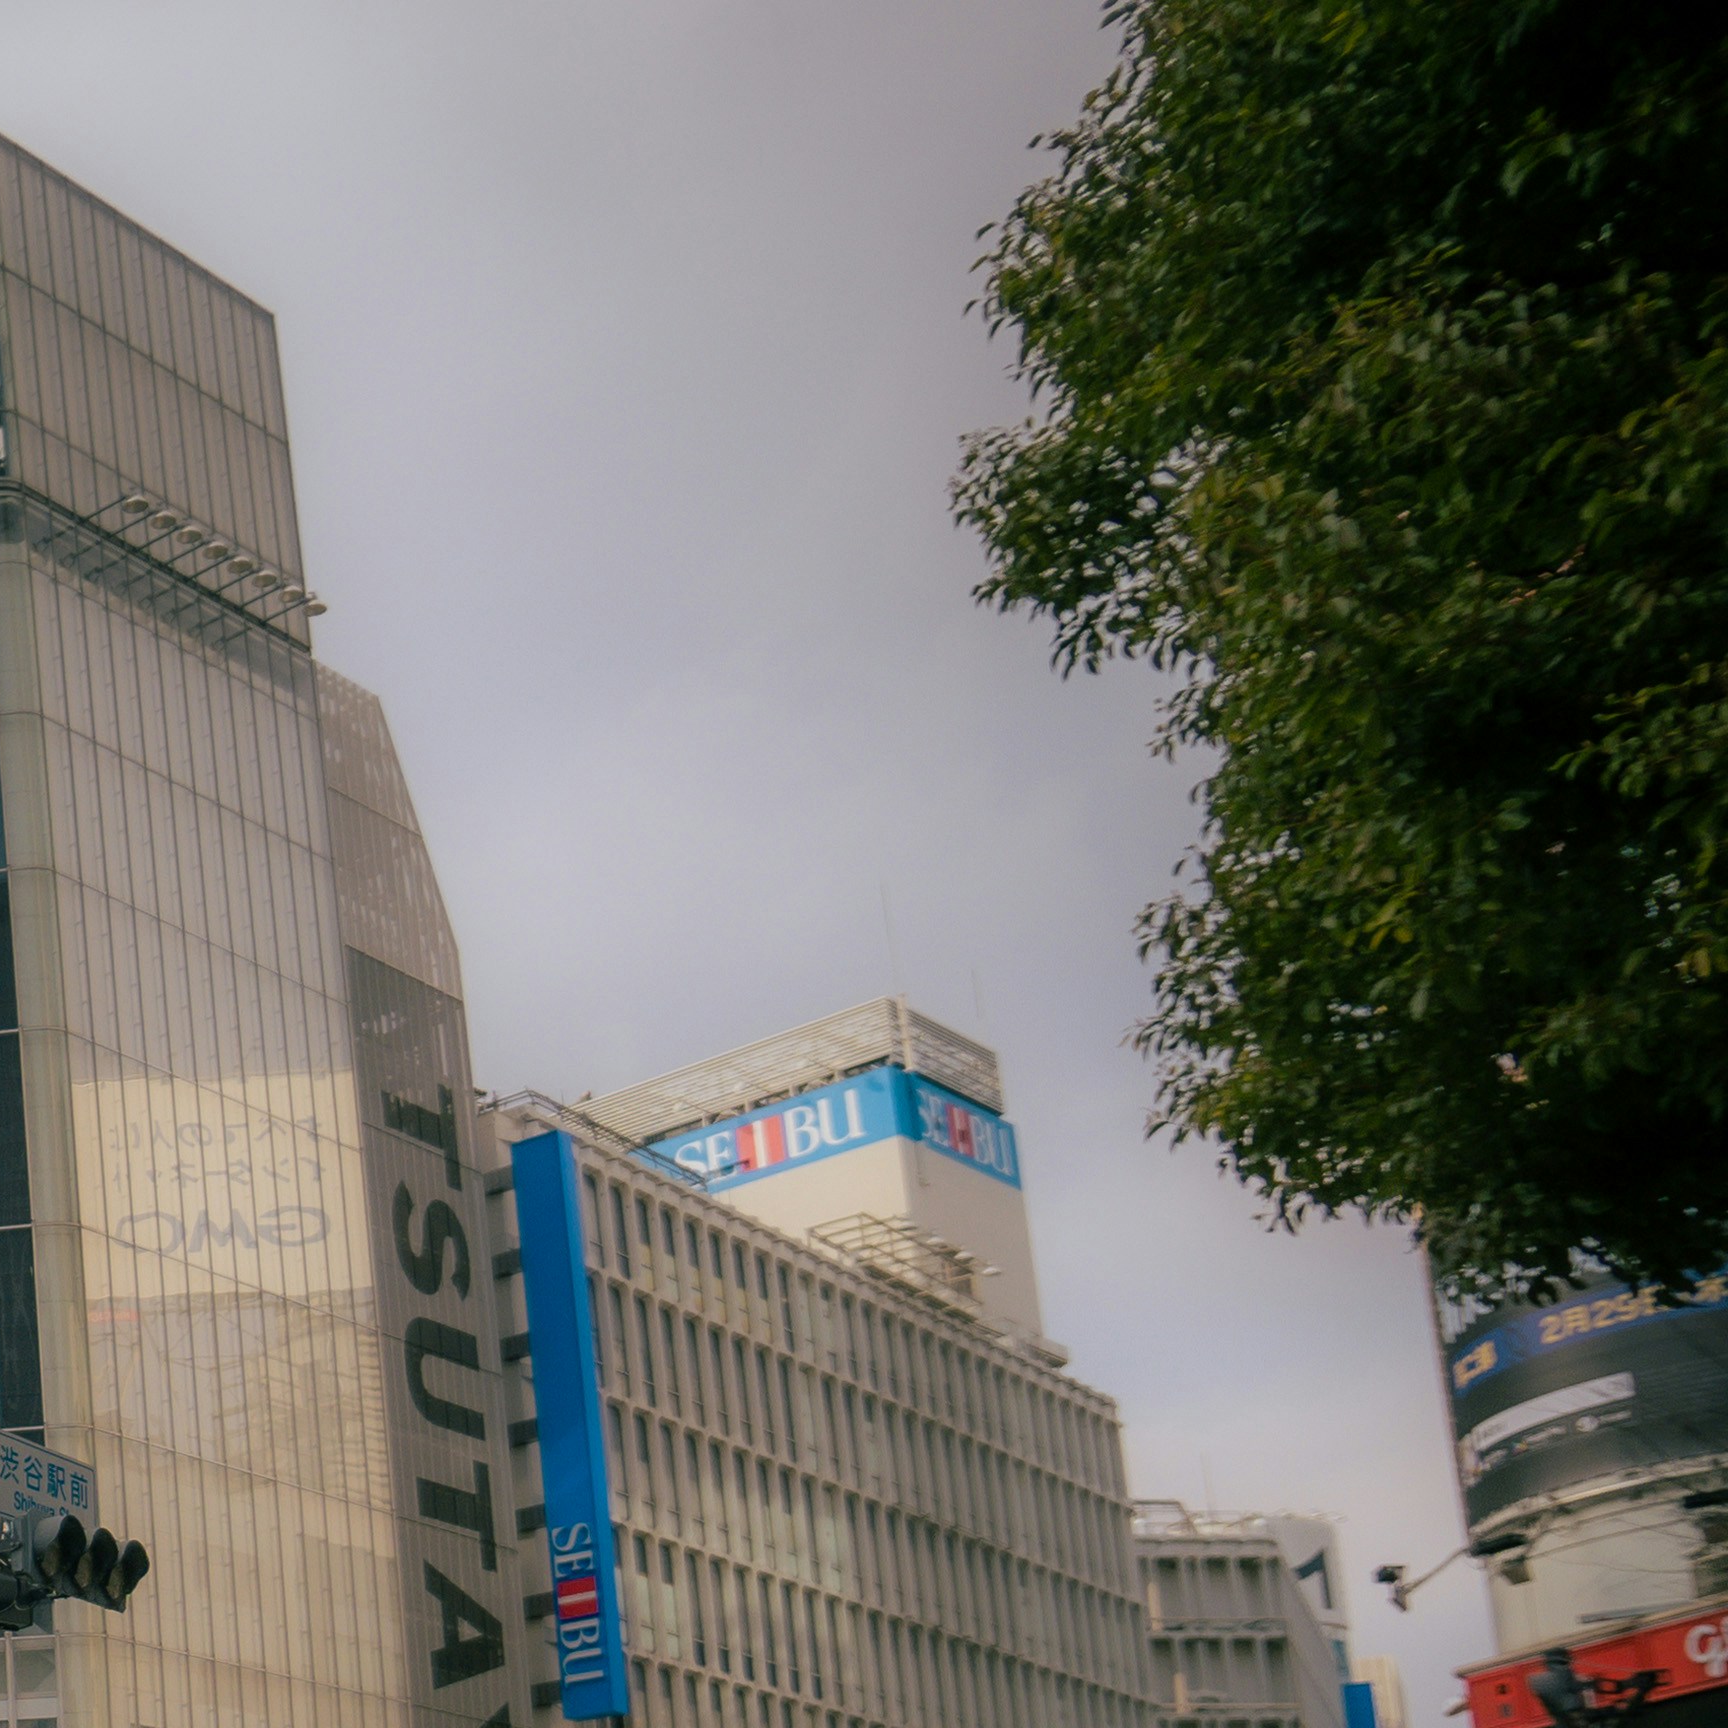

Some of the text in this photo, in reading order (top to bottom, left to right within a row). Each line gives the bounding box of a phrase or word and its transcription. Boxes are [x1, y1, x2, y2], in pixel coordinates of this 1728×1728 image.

[674, 1088, 866, 1180] SEIBU
[0, 1445, 89, 1510] 渋谷駅前
[551, 1522, 607, 1688] SEIBU
